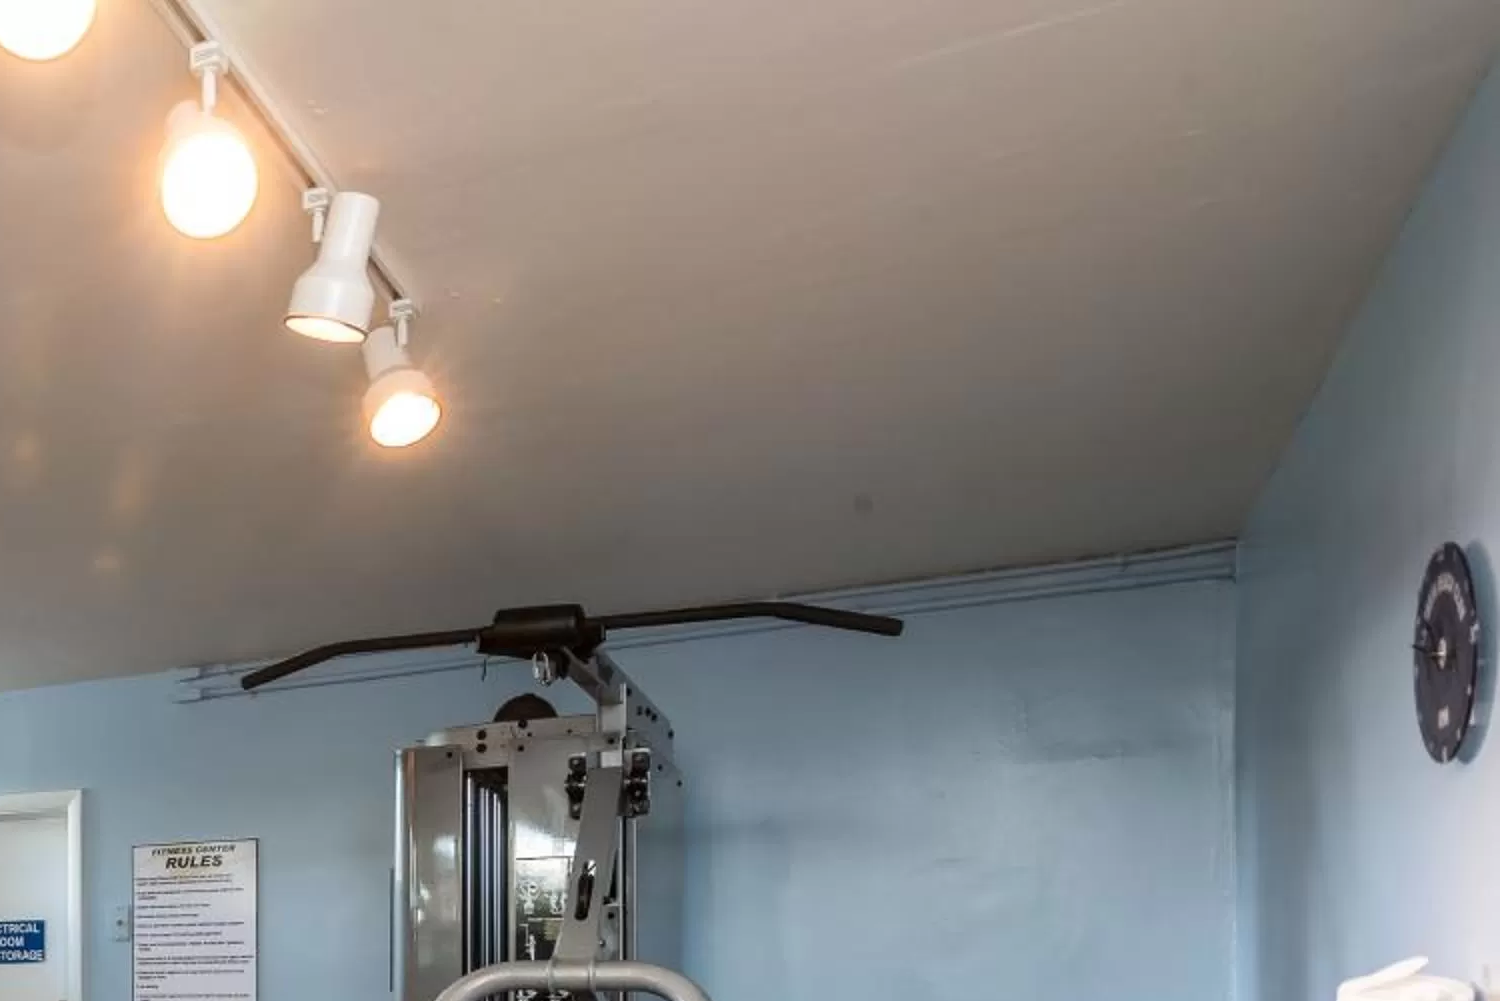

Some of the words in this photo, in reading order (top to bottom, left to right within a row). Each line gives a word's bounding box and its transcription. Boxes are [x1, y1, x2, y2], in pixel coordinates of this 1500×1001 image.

[151, 847, 193, 856] FITNESS
[195, 845, 236, 853] CENTER
[166, 855, 223, 869] RULES
